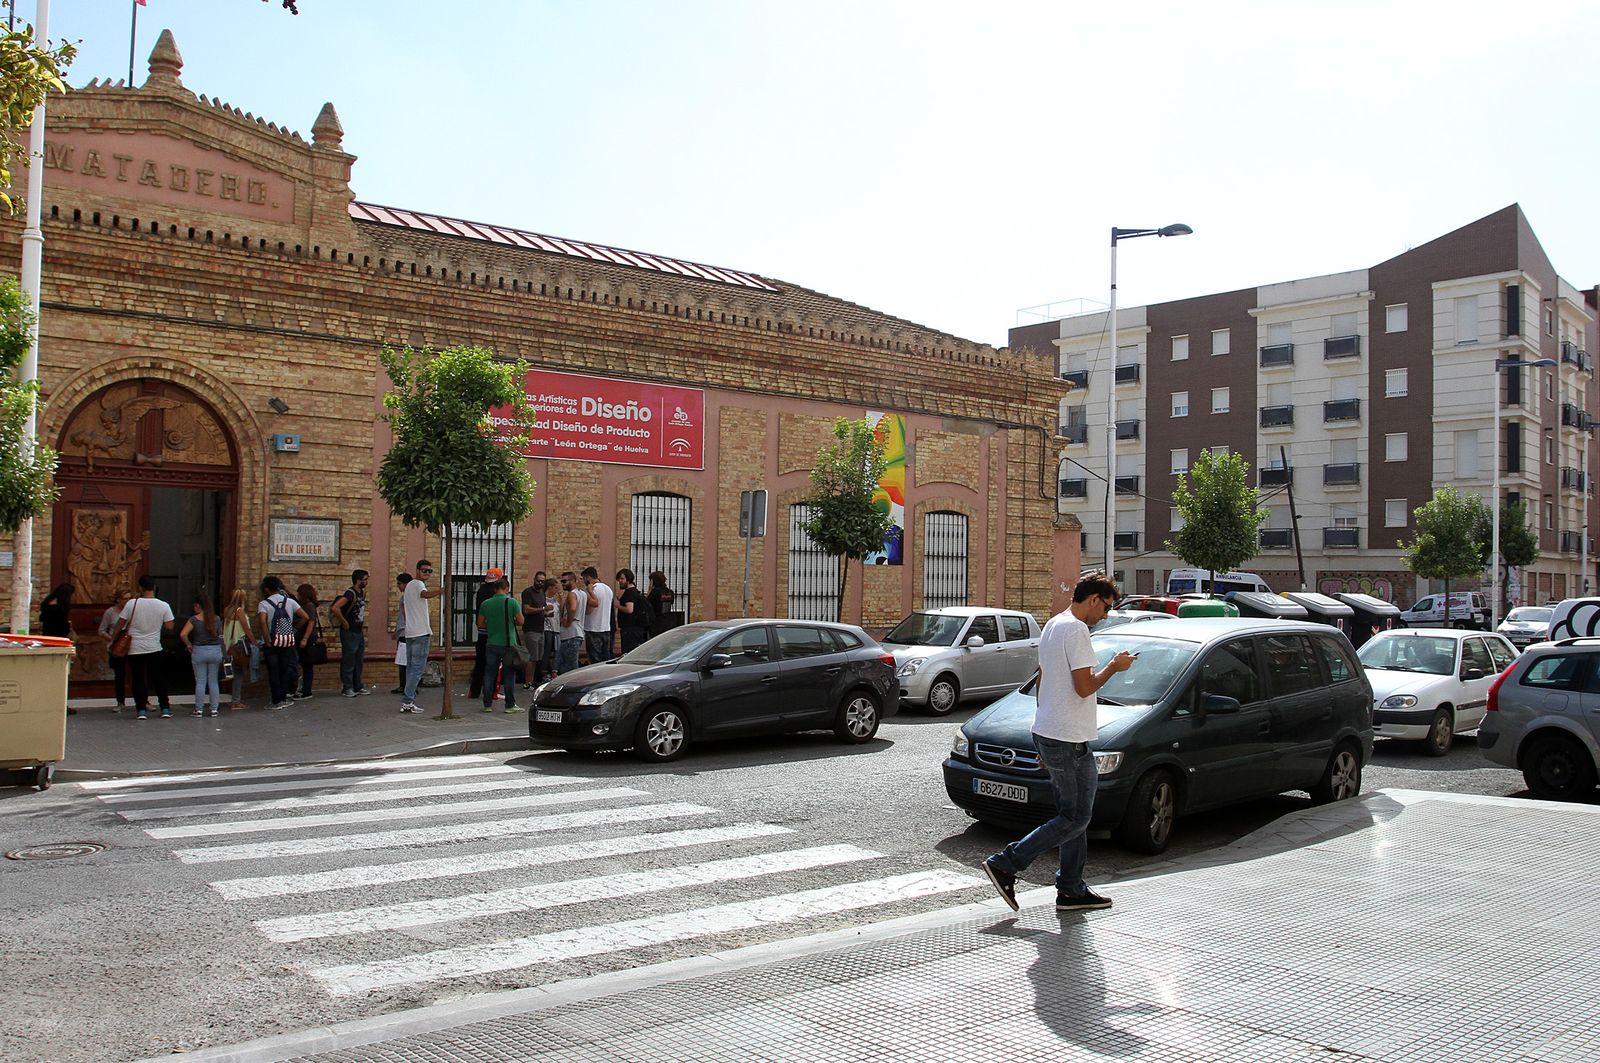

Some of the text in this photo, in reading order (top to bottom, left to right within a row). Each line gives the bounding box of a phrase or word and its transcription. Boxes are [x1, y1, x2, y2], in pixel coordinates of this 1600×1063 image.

[539, 394, 578, 406] Artísticas
[520, 403, 578, 415] periores de
[581, 396, 652, 422] Diseño
[552, 420, 588, 433] Diseño
[590, 423, 604, 435] de
[606, 425, 651, 438] Producto
[613, 444, 623, 452] de
[624, 445, 649, 454] Huelva
[980, 781, 1026, 801] 6627 DDD
